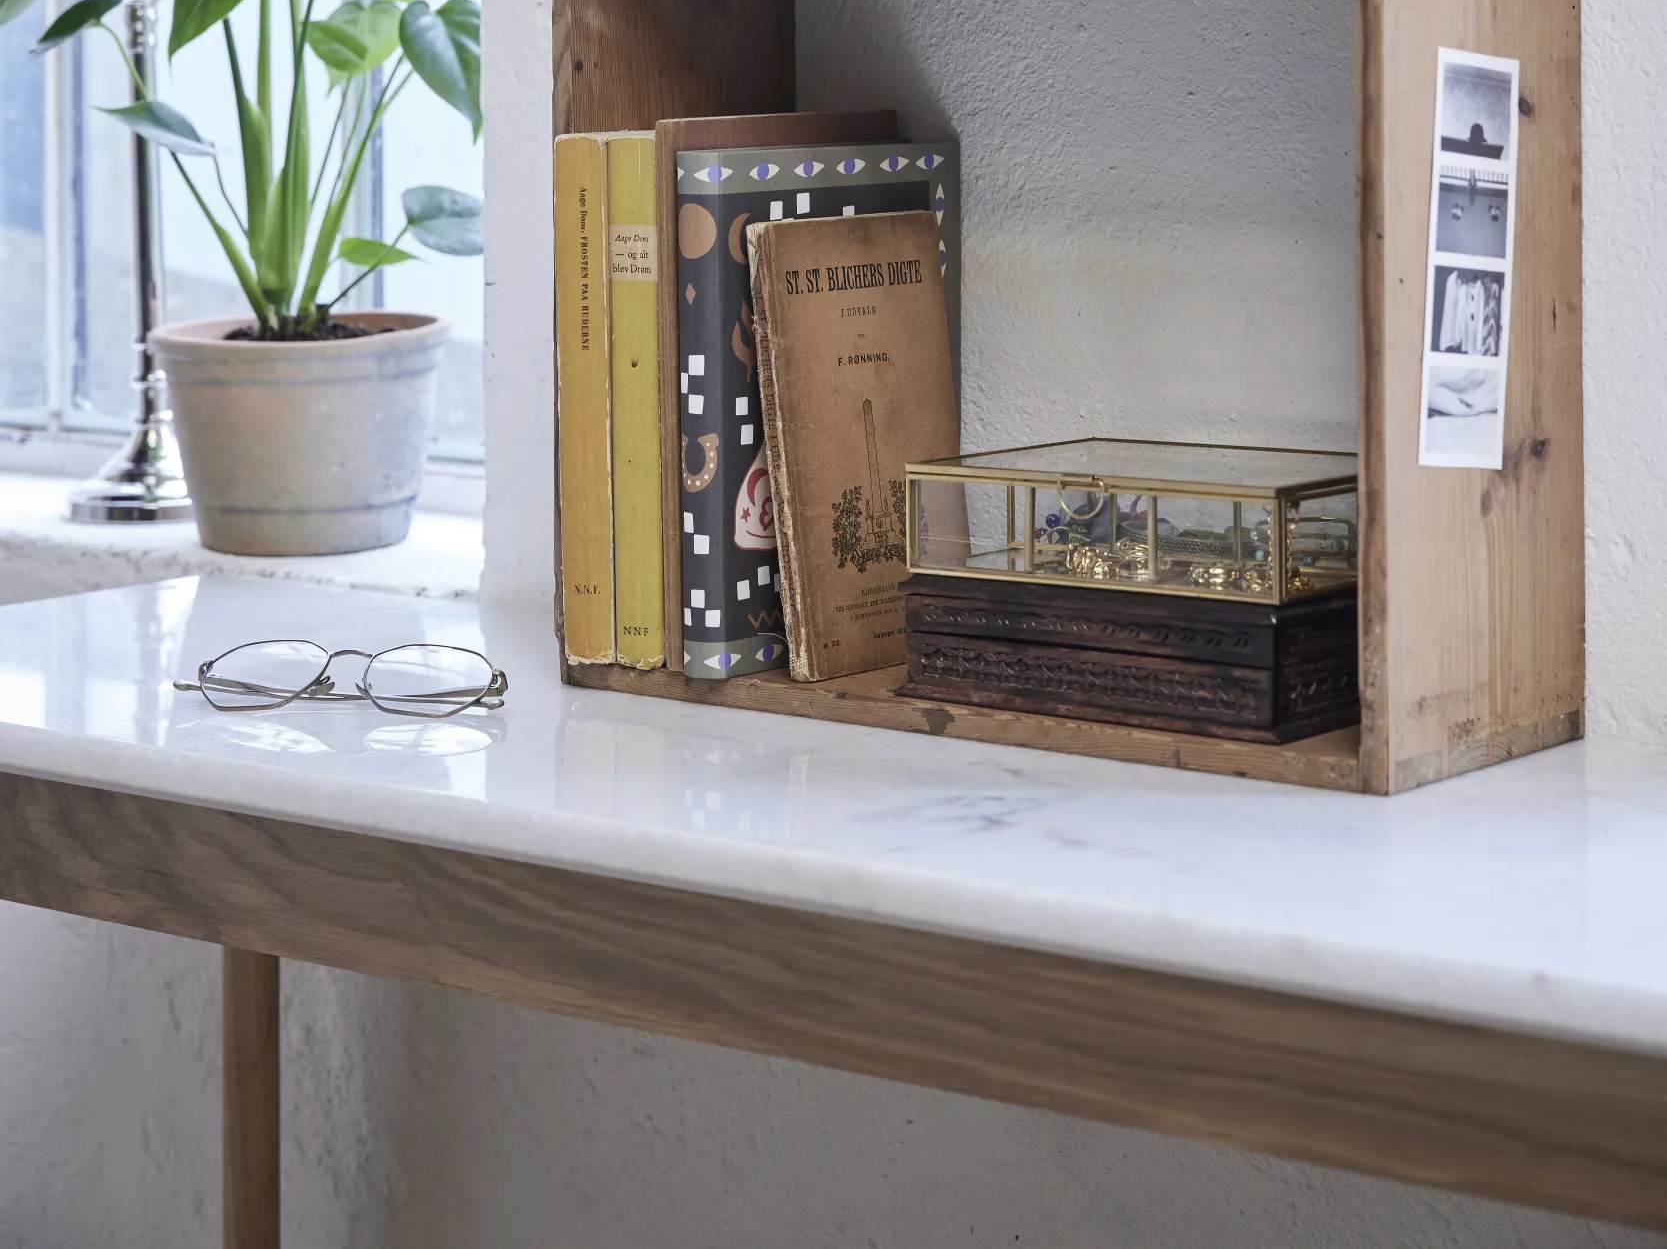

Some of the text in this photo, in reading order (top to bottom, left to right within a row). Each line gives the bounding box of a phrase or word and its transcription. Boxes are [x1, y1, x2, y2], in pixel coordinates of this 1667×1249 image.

[580, 237, 588, 279] FROSTEN
[627, 252, 637, 260] og
[640, 250, 649, 259] alt
[612, 263, 629, 273] blev
[785, 270, 804, 295] ST.
[806, 268, 824, 293] ST.
[826, 263, 885, 292] BLICHERS
[887, 260, 922, 286] DIGTE
[581, 283, 589, 301] PAA
[841, 308, 845, 317] I
[581, 305, 590, 351] RUDERNE
[838, 352, 890, 366] F. RØNNING.
